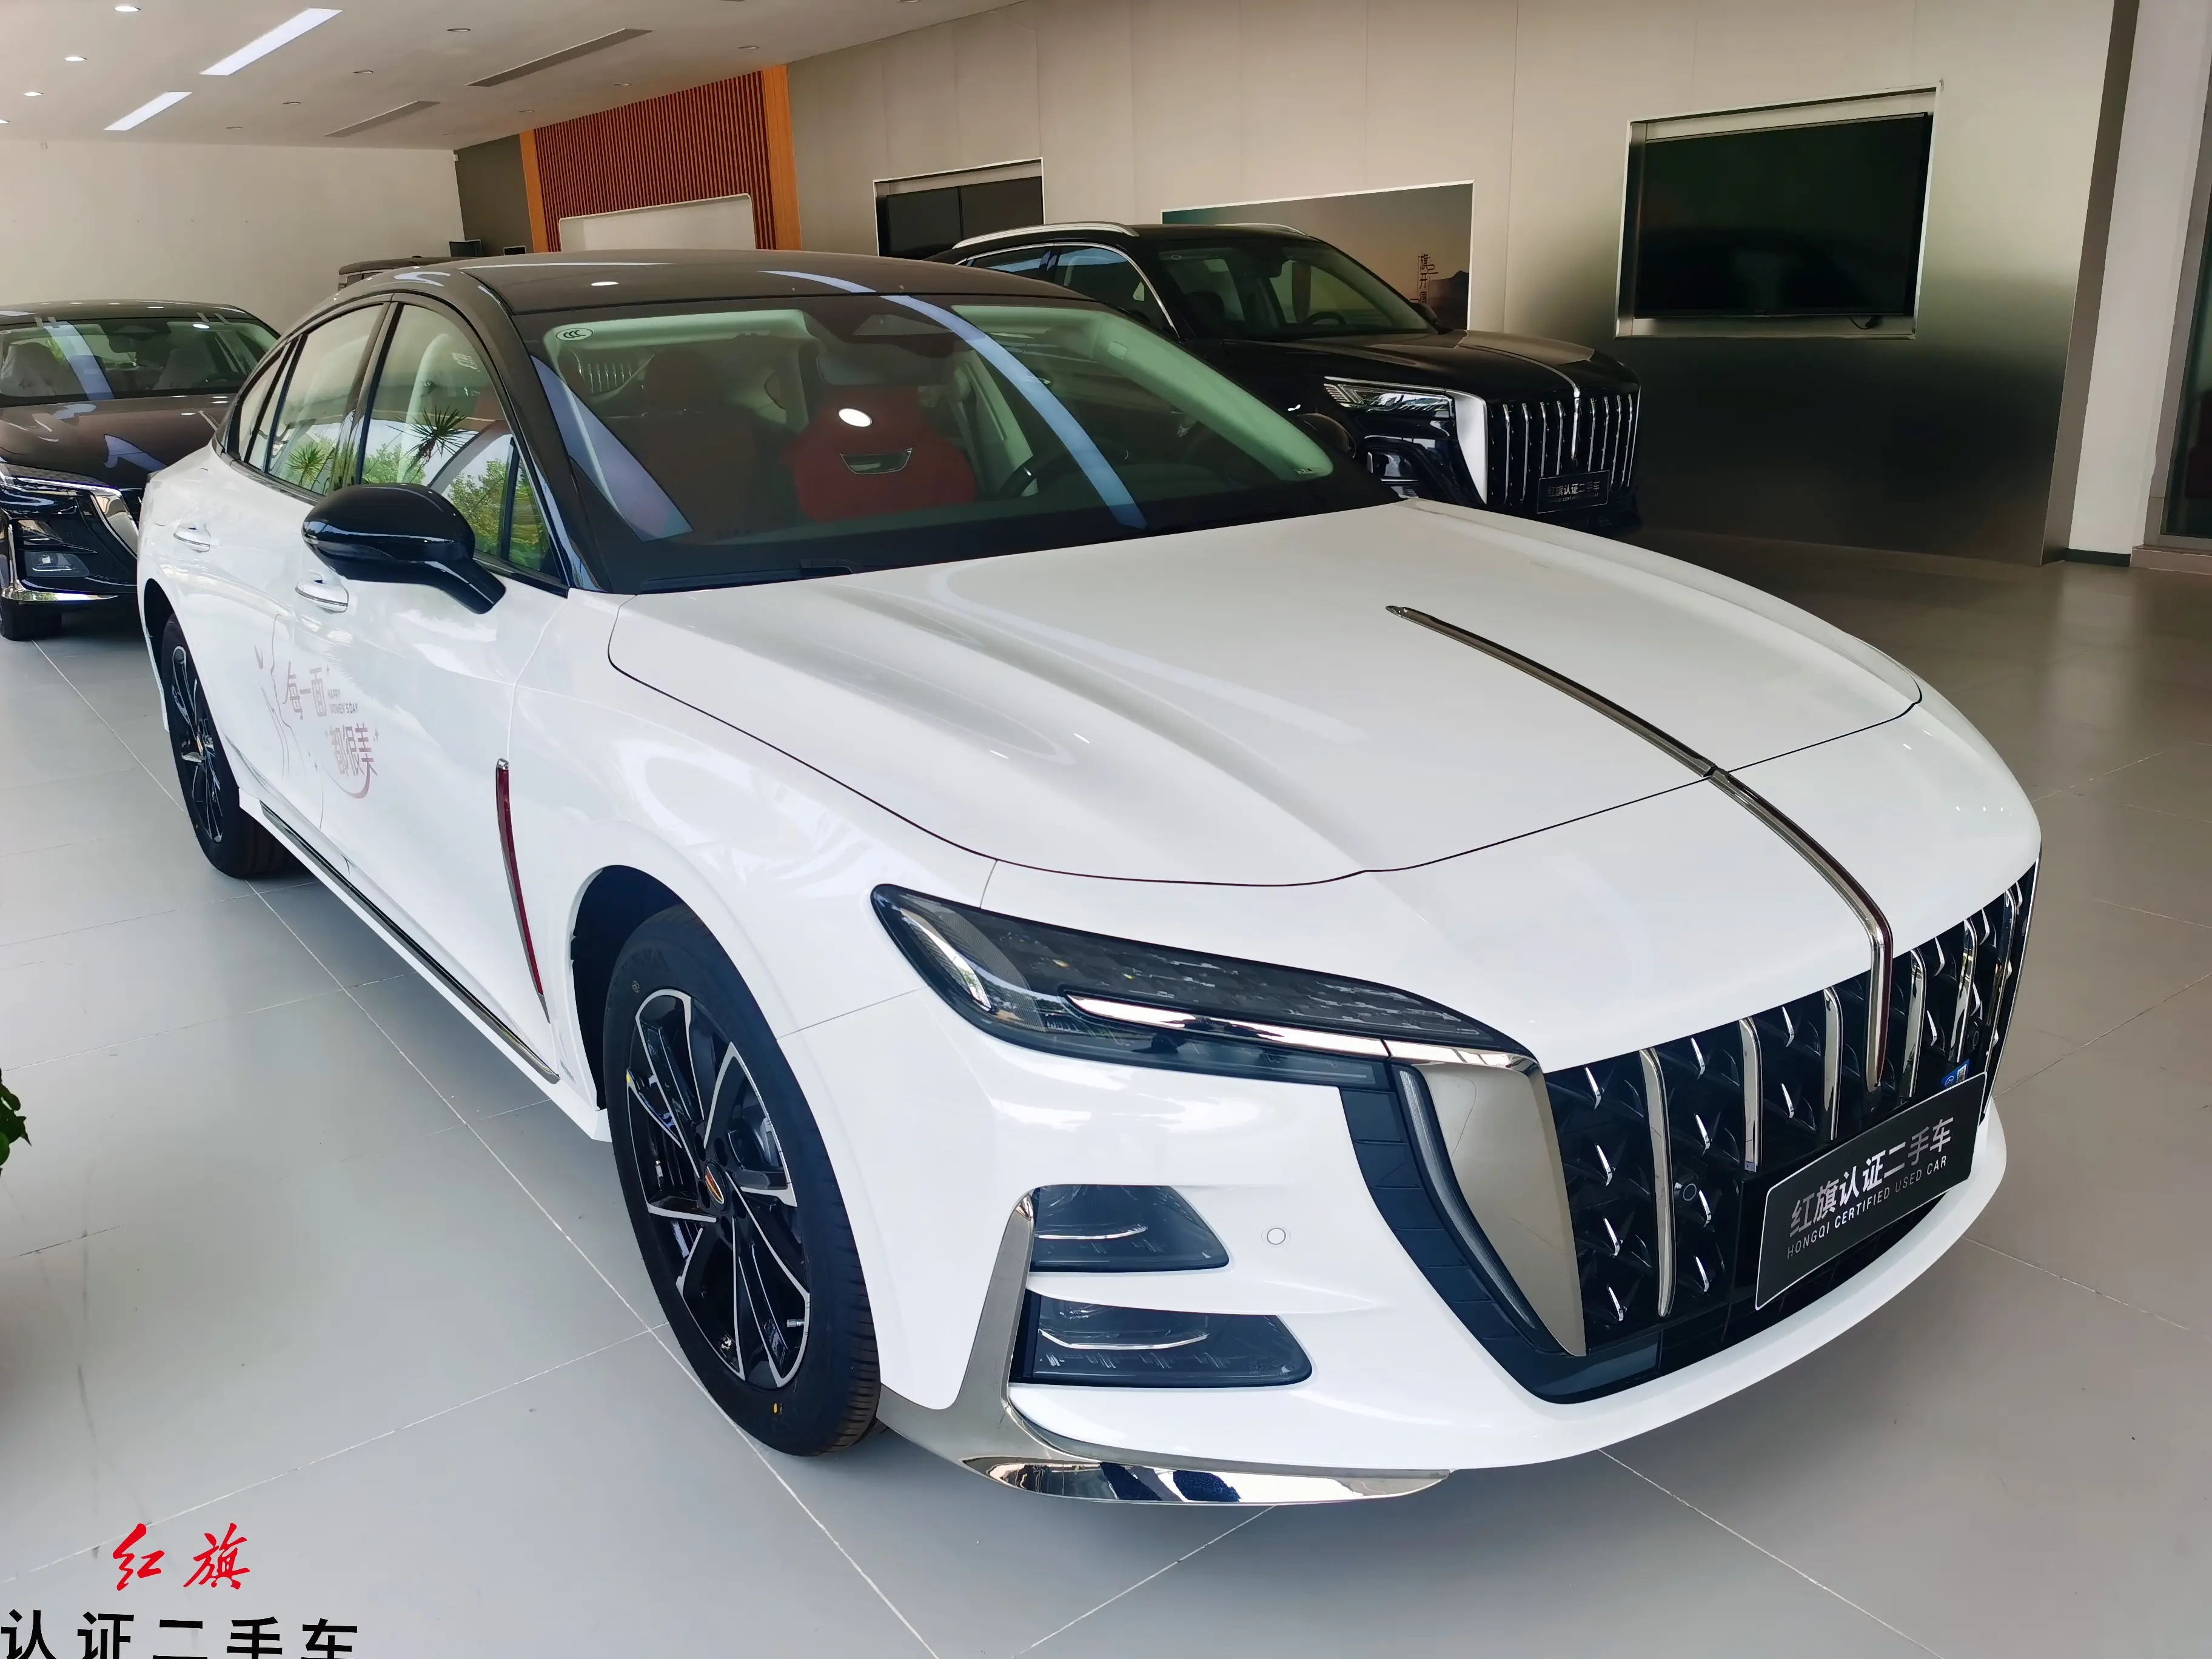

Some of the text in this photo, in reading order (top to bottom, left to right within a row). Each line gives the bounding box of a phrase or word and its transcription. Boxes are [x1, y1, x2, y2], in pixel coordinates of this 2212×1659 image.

[283, 661, 327, 720] 每一面
[327, 722, 378, 792] 都很美
[1787, 1155, 1947, 1259] HONGQI CERTIFIED USED CAR
[1789, 1117, 1954, 1238] 红旗认证二手车
